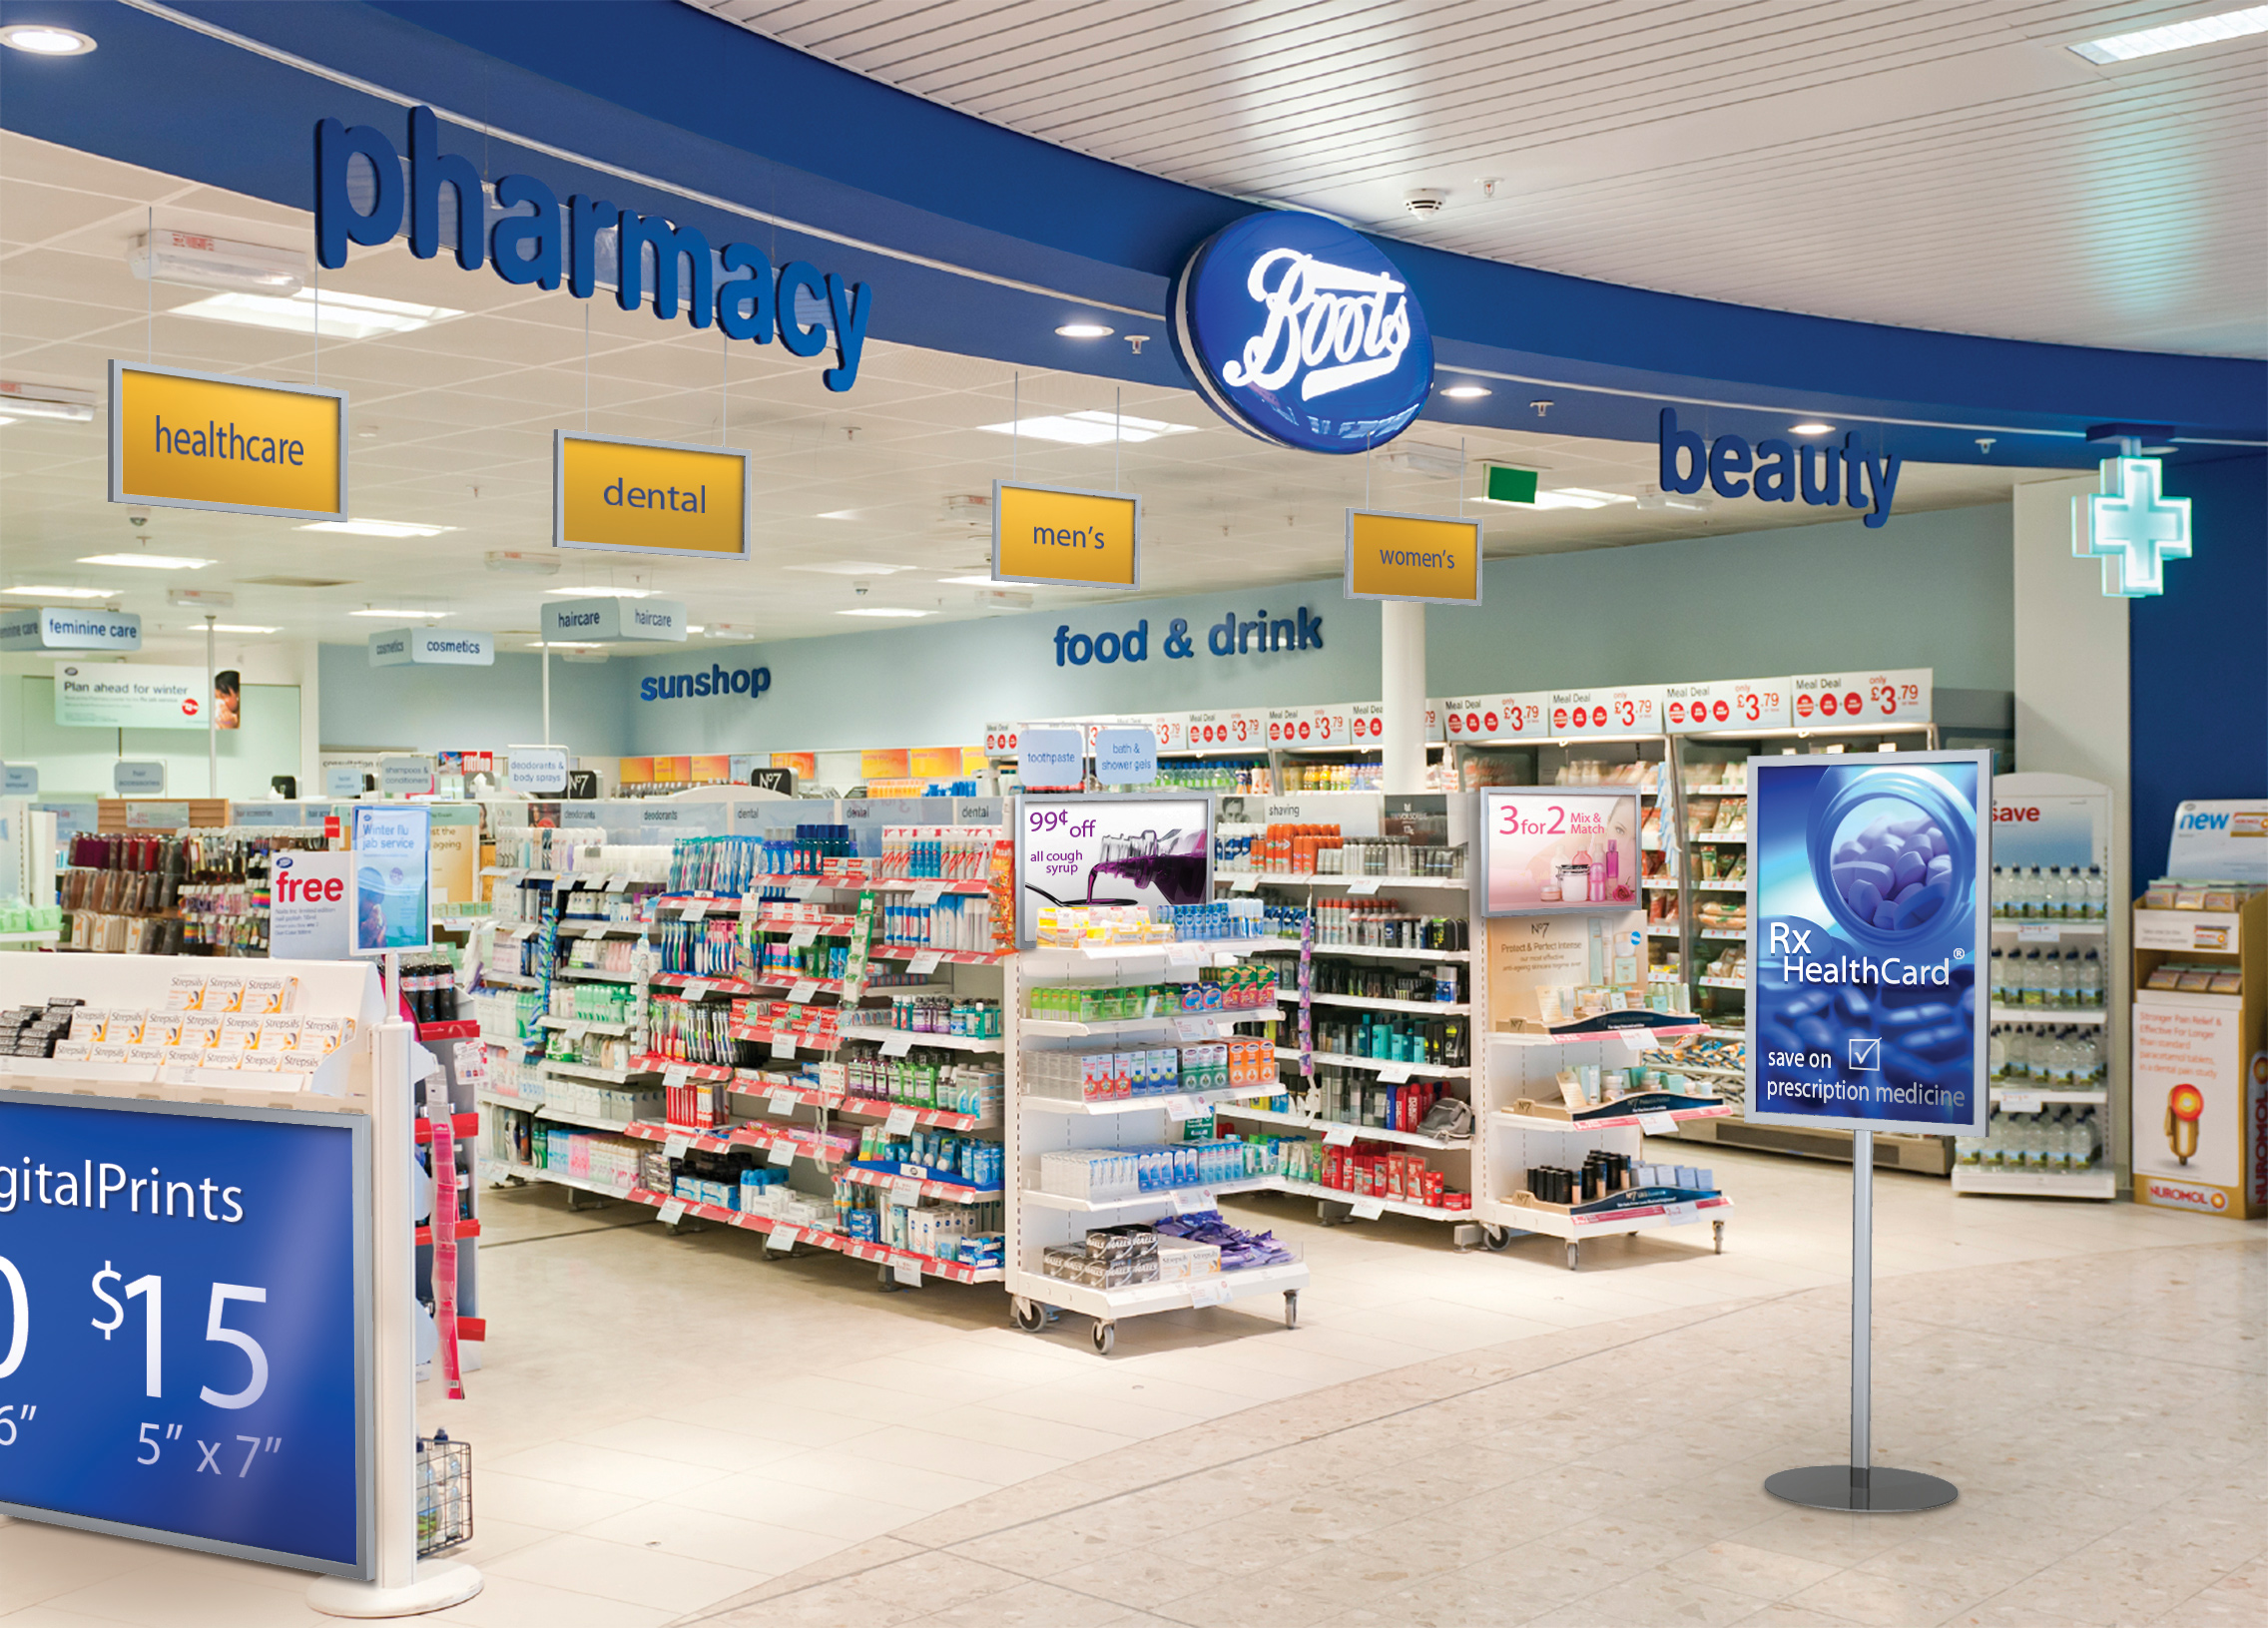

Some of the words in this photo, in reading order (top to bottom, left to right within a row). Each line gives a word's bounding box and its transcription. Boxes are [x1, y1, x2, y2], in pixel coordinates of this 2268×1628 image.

[313, 105, 870, 391] pharmacy
[1223, 248, 1411, 400] Boots
[156, 415, 304, 468] healthcare
[1659, 407, 1902, 529] beauty
[603, 477, 707, 515] dental
[1033, 523, 1105, 550] men's
[1380, 548, 1455, 570] women's
[558, 609, 600, 629] haircare
[634, 609, 673, 629] haircare
[50, 618, 107, 638] feminine
[109, 624, 137, 639] care
[1054, 619, 1148, 667] food
[1163, 617, 1194, 659] &
[1209, 607, 1324, 657] drink
[376, 639, 404, 655] cosmetics
[426, 640, 480, 655] cosmetics
[640, 664, 772, 701] sunshop
[1796, 679, 1818, 690] Meal
[1820, 678, 1842, 689] Deal
[1869, 675, 1887, 686] only
[64, 681, 90, 693] Plan
[94, 682, 129, 694] ahead
[133, 684, 150, 695] for
[153, 685, 189, 696] winter
[1667, 688, 1688, 698] Meal
[1690, 686, 1710, 697] Deal
[1735, 685, 1751, 694] only
[1553, 695, 1572, 704] Meal
[1573, 694, 1591, 703] Deal
[1613, 691, 1627, 700] only
[1871, 685, 1919, 715] £3.79
[1353, 706, 1370, 715] Meal
[1371, 705, 1383, 714] Dea
[1445, 701, 1463, 710] Meal
[1465, 700, 1481, 709] Deal
[1737, 693, 1780, 721] £3.79
[1269, 711, 1283, 720] Meal
[1284, 710, 1298, 719] Deal
[1503, 706, 1539, 732] £3.79
[1614, 700, 1652, 727] £3.79
[1232, 719, 1260, 742] £3.79
[1315, 716, 1344, 740] £3.79
[1112, 743, 1132, 754] bath
[1133, 744, 1141, 755] &
[1027, 752, 1075, 766] toothpaste
[1101, 759, 1133, 771] shower
[1134, 759, 1152, 772] gels
[511, 761, 555, 771] deodorants
[557, 761, 564, 770] &
[513, 772, 534, 784] body
[536, 773, 561, 784] sprays
[643, 811, 678, 821] deodorants
[737, 808, 760, 819] dental
[961, 806, 989, 818] dental
[1269, 804, 1300, 817] shaving
[1029, 809, 1069, 832] 99¢
[1069, 818, 1097, 838] off
[1570, 813, 1591, 823] Mix
[1593, 813, 1602, 823] &
[2179, 813, 2230, 830] new
[362, 824, 395, 835] Winter
[397, 823, 409, 835] flu
[1570, 823, 1605, 834] Match
[362, 838, 378, 850] jab
[380, 838, 414, 848] service
[1030, 850, 1044, 862] all
[1045, 849, 1083, 865] cough
[1045, 863, 1079, 876] syrup
[276, 870, 344, 903] free
[1770, 921, 1812, 955] Rx
[1500, 943, 1526, 953] Protect
[1526, 942, 1532, 952] &
[1533, 941, 1557, 952] Perfect
[1557, 941, 1582, 950] Intense
[171, 977, 204, 988] Strepsils
[209, 978, 243, 989] Strepsils
[248, 979, 283, 990] Strepsils
[75, 1010, 106, 1021] Strepsils
[111, 1012, 143, 1023] Strepsils
[150, 1013, 182, 1025] Strepsils
[187, 1014, 220, 1027] Strepsils
[2139, 1011, 2173, 1024] Stronger
[2174, 1013, 2191, 1024] Pain
[2192, 1015, 2214, 1026] Relief
[226, 1016, 260, 1029] Strepsils
[265, 1018, 300, 1029] Strepsils
[304, 1019, 339, 1032] Strepsils
[2139, 1024, 2173, 1036] Effective
[2174, 1026, 2187, 1036] For
[2188, 1028, 2215, 1040] Longer
[57, 1044, 88, 1056] Strepsils
[2158, 1037, 2191, 1050] standard
[94, 1045, 125, 1057] Strepsils
[130, 1047, 163, 1060] Strepsils
[168, 1049, 201, 1062] Strepsils
[2139, 1051, 2186, 1063] paracetamol
[207, 1051, 239, 1065] Strepsils
[245, 1053, 280, 1066] Strepsils
[284, 1054, 319, 1068] Strepsils
[1768, 1052, 1804, 1070] save
[1809, 1053, 1832, 1070] on
[2153, 1063, 2176, 1075] dental
[2177, 1065, 2194, 1077] pain
[2196, 1067, 2218, 1080] study
[1766, 1078, 1870, 1106] prescription
[1875, 1083, 1966, 1108] medicine
[2149, 1185, 2208, 1205] NUROMOL
[91, 1260, 270, 1410] $15
[196, 1439, 222, 1476] x
